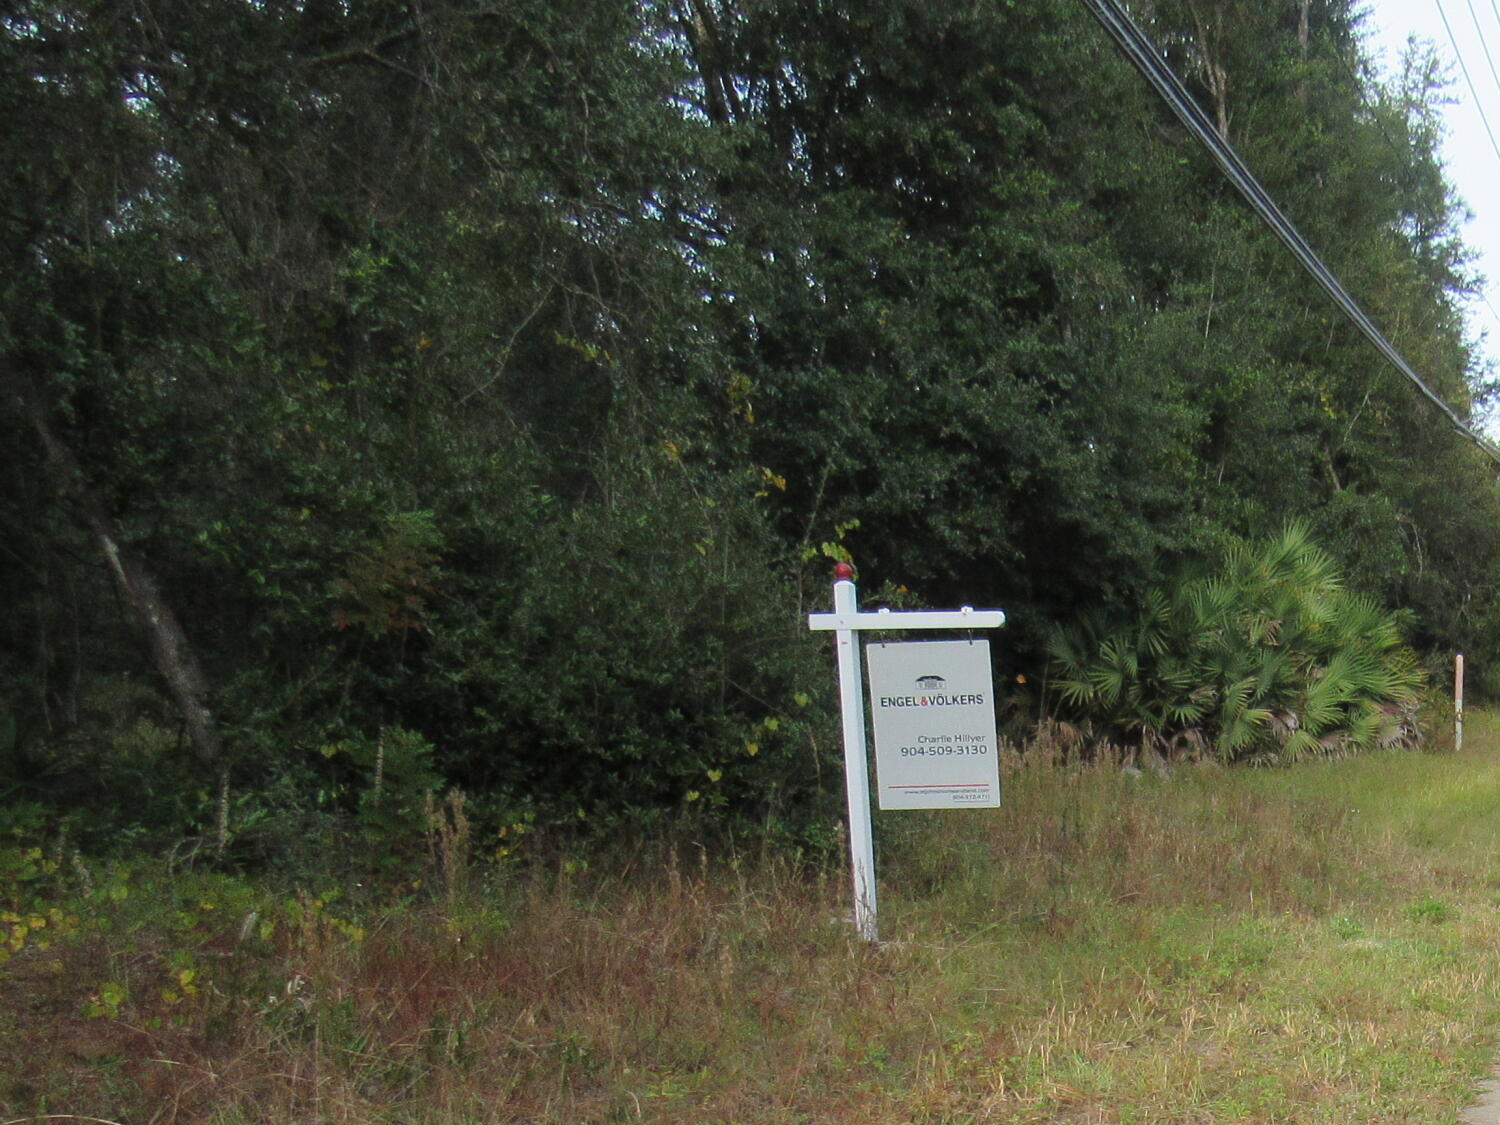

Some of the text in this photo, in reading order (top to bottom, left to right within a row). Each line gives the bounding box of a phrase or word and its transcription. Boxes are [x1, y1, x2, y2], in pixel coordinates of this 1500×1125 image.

[917, 734, 986, 744] Charlie Hillyer
[901, 745, 987, 756] 904-509-3130
